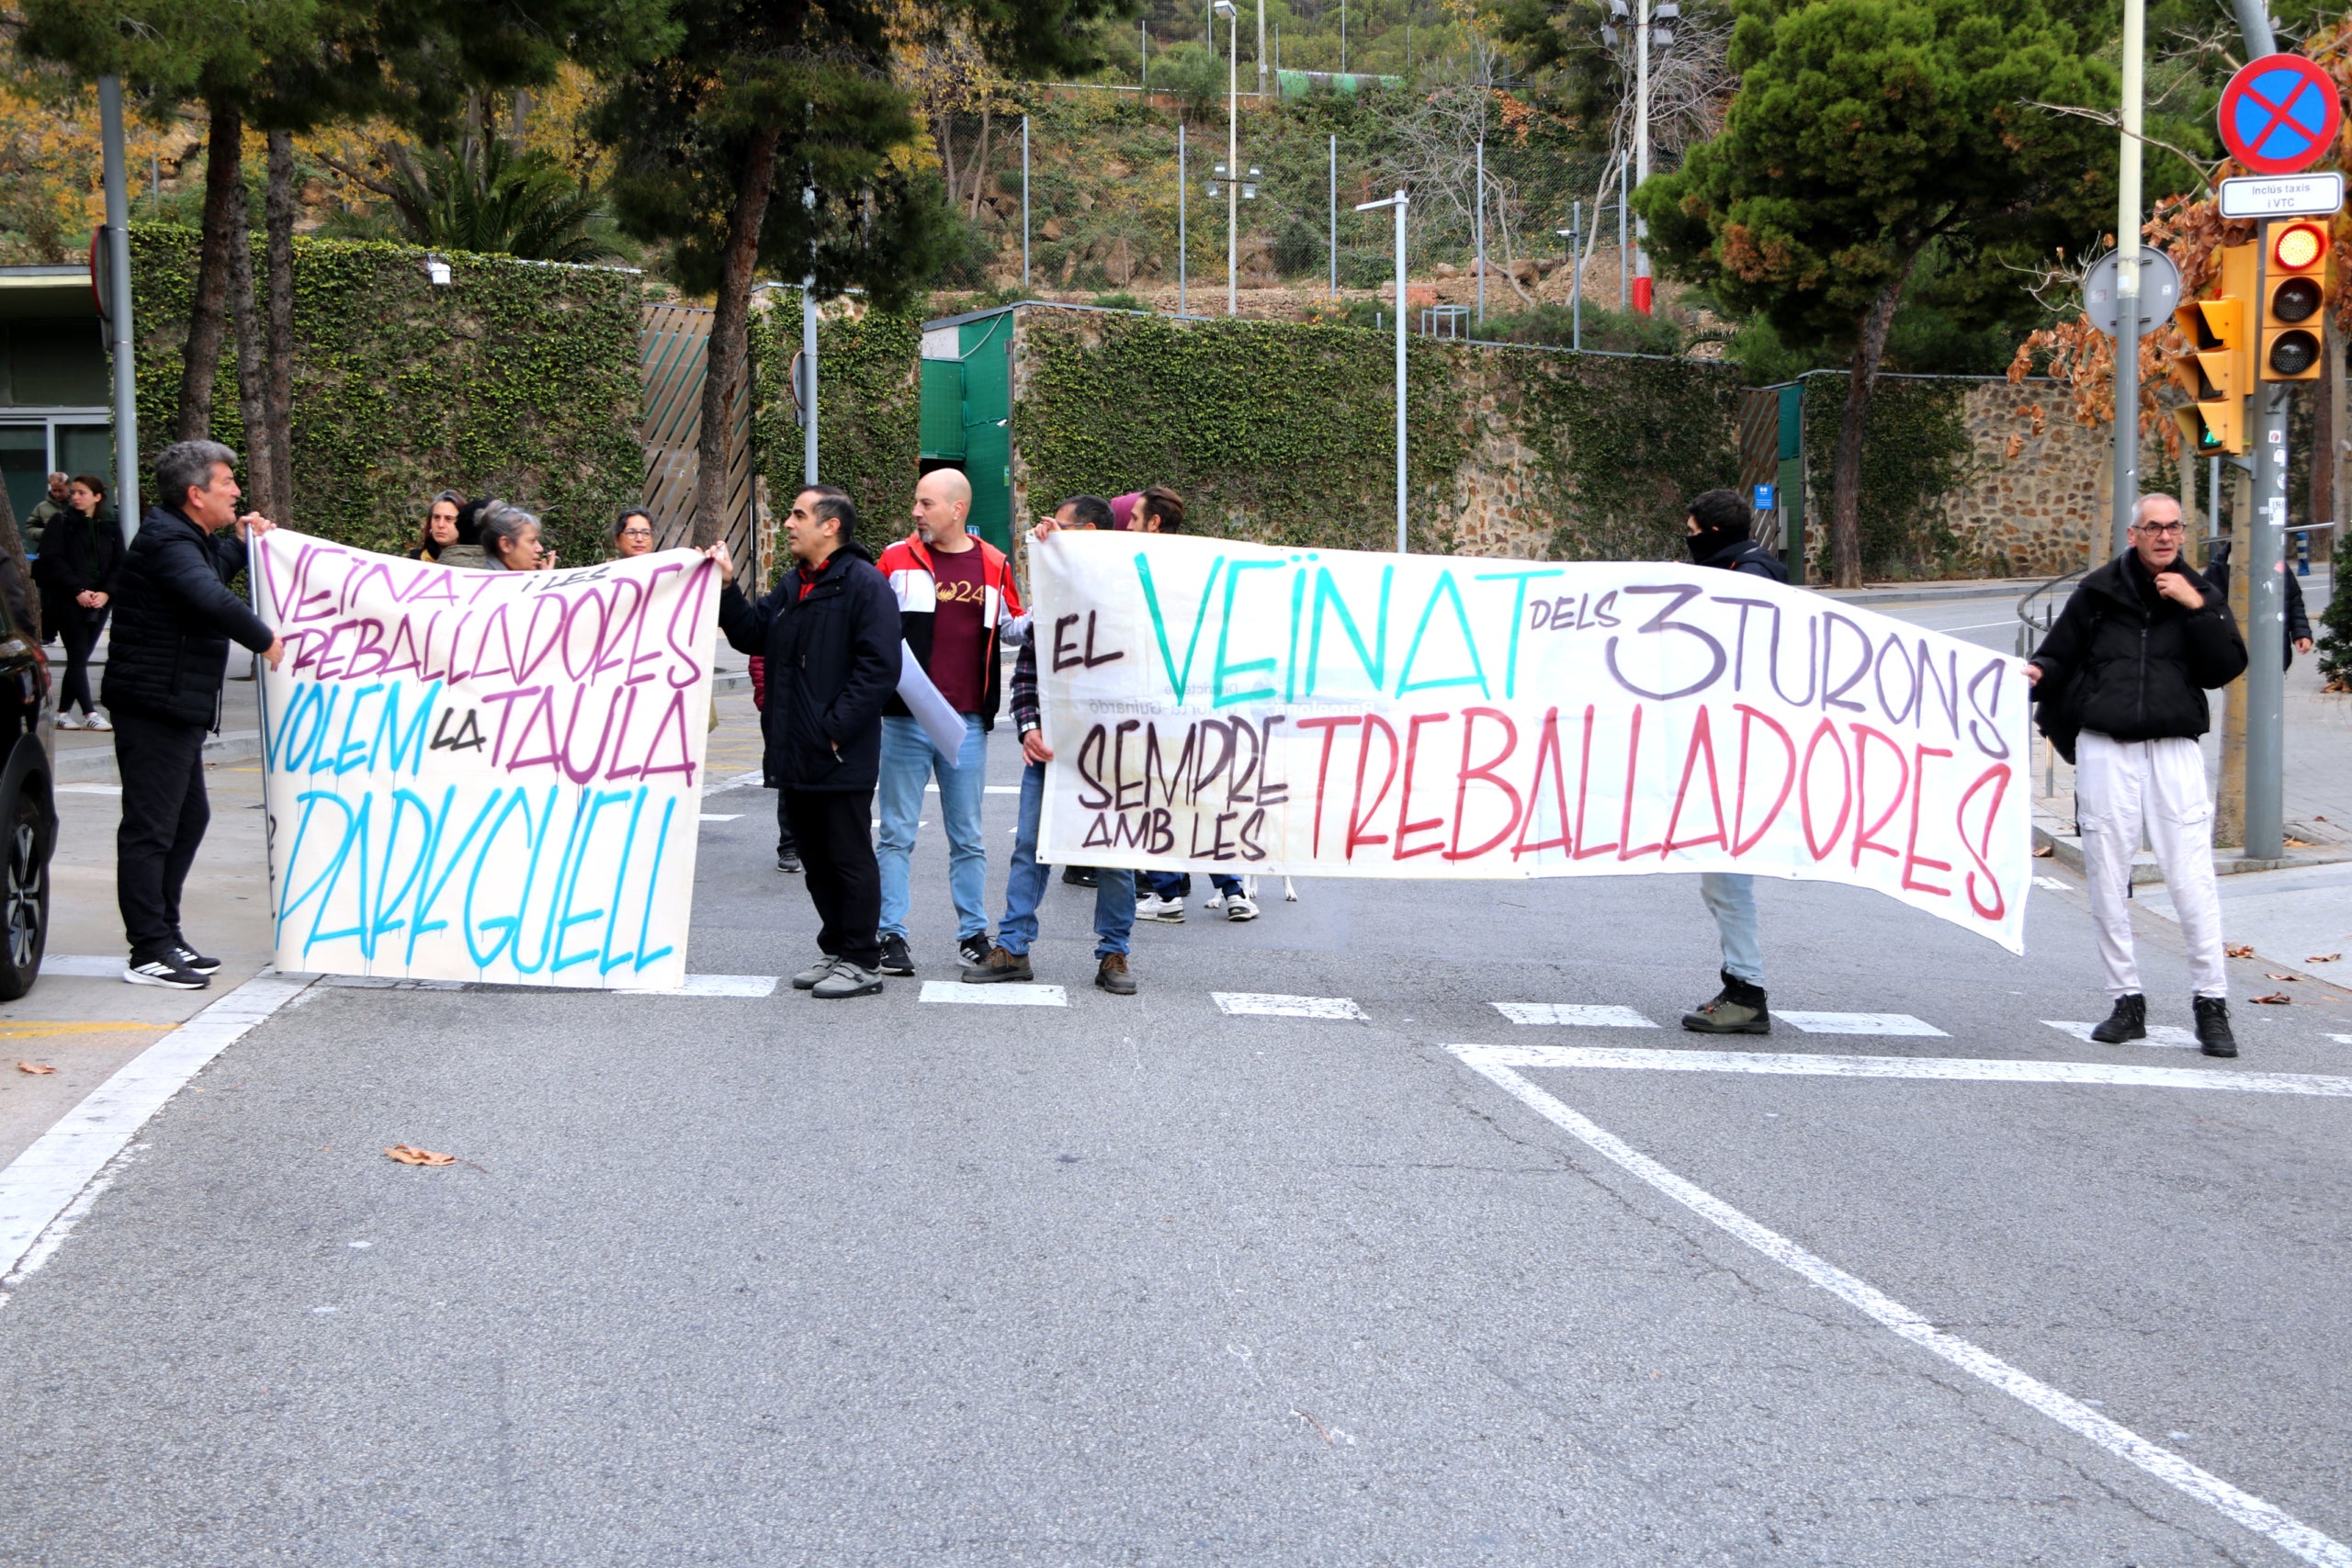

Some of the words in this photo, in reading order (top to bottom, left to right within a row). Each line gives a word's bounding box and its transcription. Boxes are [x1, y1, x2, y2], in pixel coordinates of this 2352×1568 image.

[2274, 197, 2295, 208] VTC
[2285, 184, 2311, 194] taxis
[261, 538, 525, 626] VEÏNAT
[540, 566, 611, 591] LES
[955, 580, 985, 606] 24
[1051, 609, 1125, 673] EL
[1134, 551, 1565, 707] VEÏNAT
[1529, 589, 1622, 631] DELS
[1604, 583, 1727, 702] 3
[1711, 596, 2010, 761] TURONS
[264, 681, 443, 778] VOLEM
[430, 706, 488, 753] LA
[481, 682, 696, 787] TAULA
[1078, 714, 1289, 812] SEMPRE
[1082, 808, 1176, 854] AMB
[1190, 807, 1267, 862] LES
[1296, 704, 2012, 921] TREBALLADORES
[276, 784, 503, 964] PARK
[463, 784, 677, 976] GUELL
